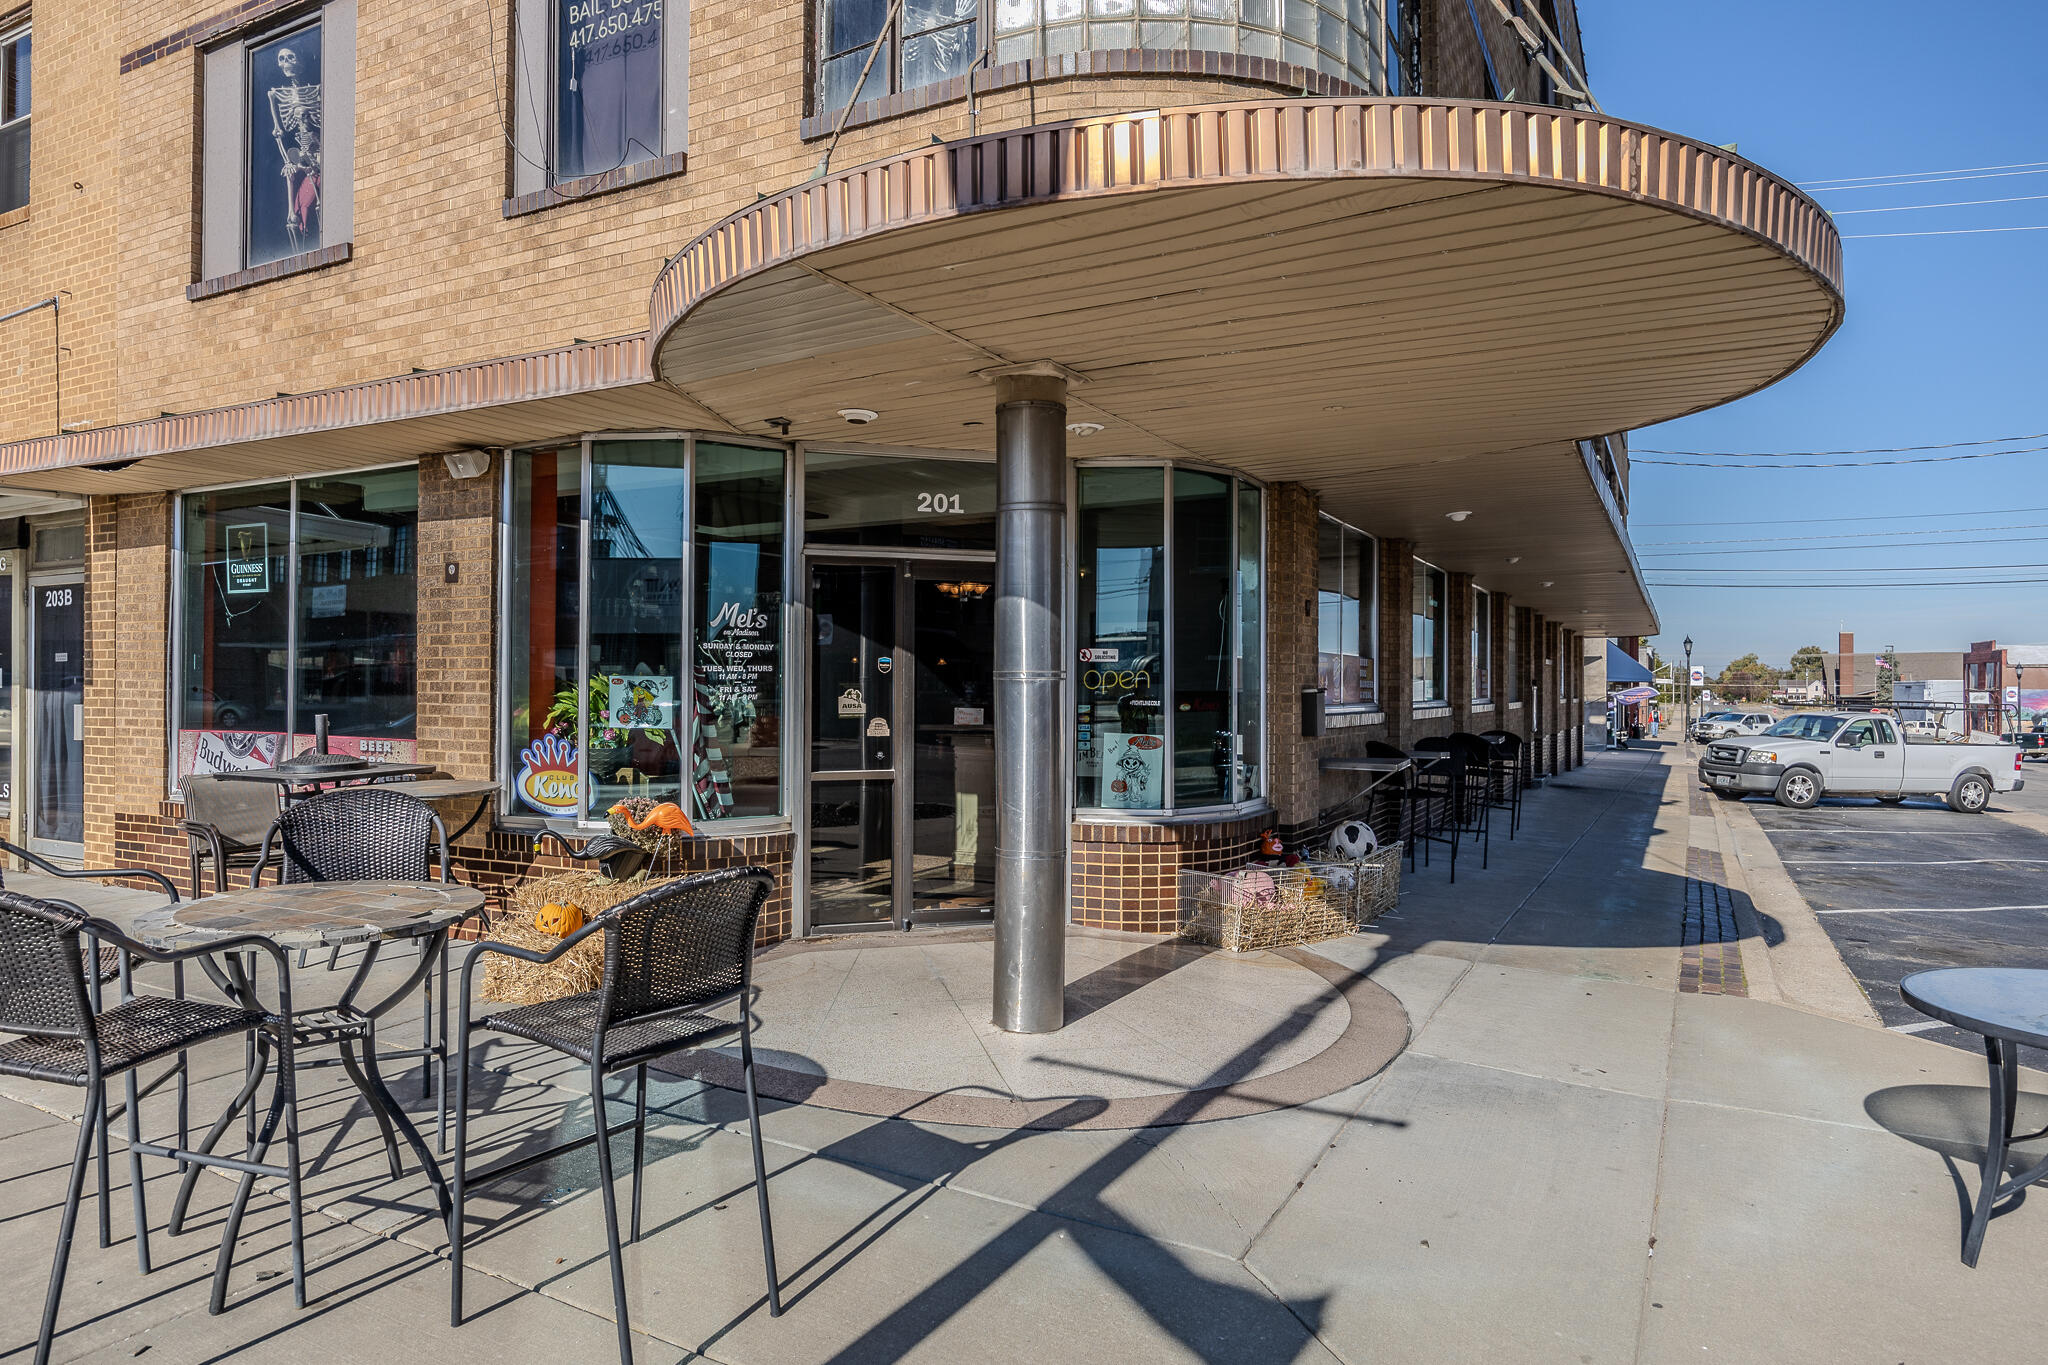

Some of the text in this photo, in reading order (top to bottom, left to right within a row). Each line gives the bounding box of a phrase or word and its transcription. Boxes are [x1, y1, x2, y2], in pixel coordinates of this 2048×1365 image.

[569, 0, 605, 24] BAIL
[917, 493, 964, 514] 201
[231, 563, 263, 574] GUINNESS
[45, 589, 73, 608] 203B
[710, 602, 768, 628] Mel's
[702, 665, 725, 673] TUES,
[360, 740, 393, 752] BEER
